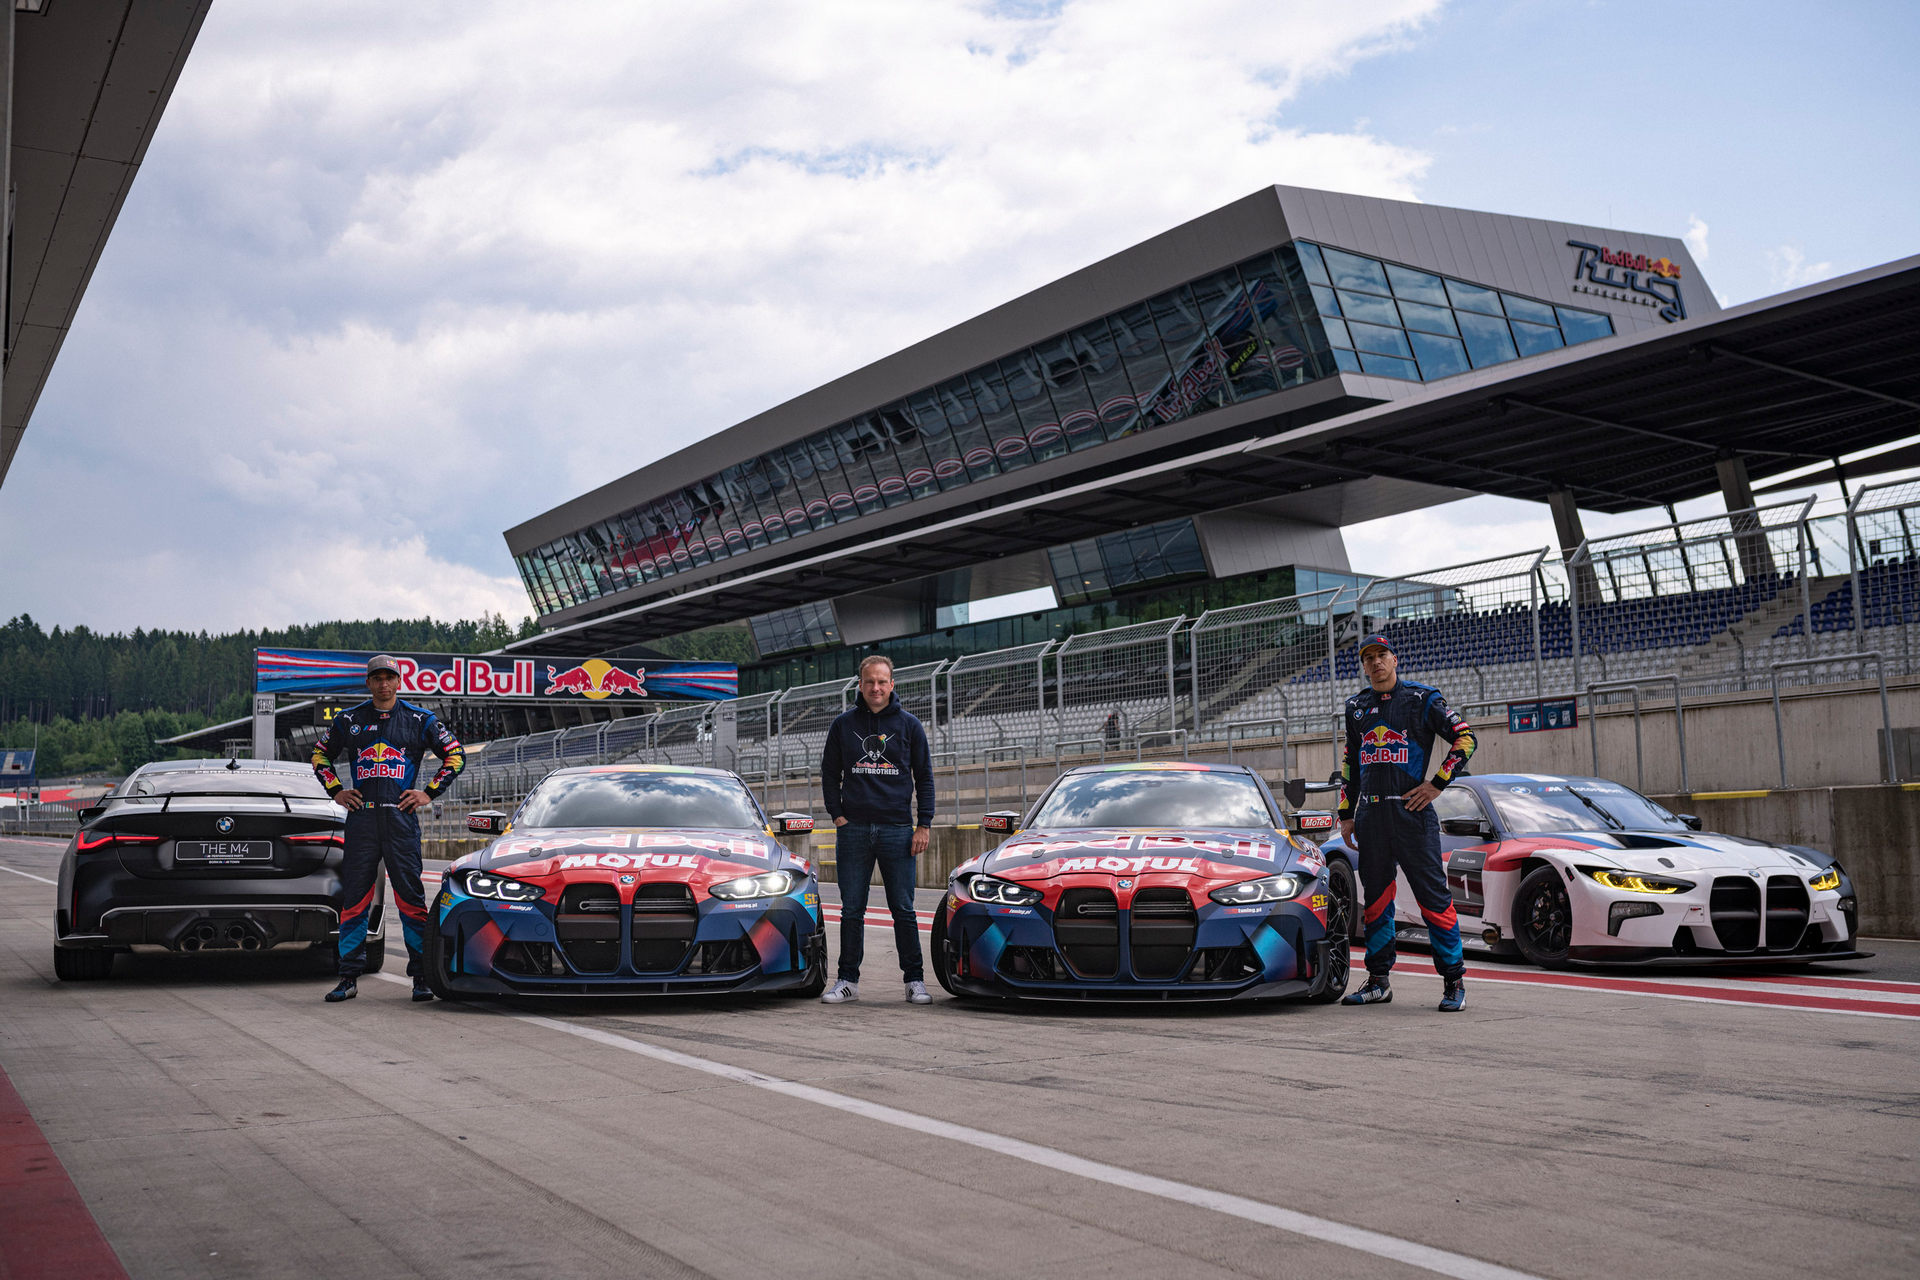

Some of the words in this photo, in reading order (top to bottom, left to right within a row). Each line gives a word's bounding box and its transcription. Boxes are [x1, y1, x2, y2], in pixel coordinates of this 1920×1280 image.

[1602, 246, 1625, 267] Red
[1625, 251, 1647, 272] Bull
[397, 657, 465, 695] Red
[467, 659, 535, 697] Bull
[1361, 748, 1380, 765] Red
[1381, 748, 1408, 764] Bull
[357, 763, 378, 780] Red
[379, 764, 405, 779] Bull
[851, 767, 899, 775] DRIFTBROTHERS
[789, 820, 813, 829] MoTeC
[983, 817, 1005, 827] MoTeC
[1305, 818, 1330, 827] MoTeC
[200, 844, 227, 854] THE
[230, 844, 249, 854] M4
[560, 853, 699, 870] MOTUL
[1058, 856, 1201, 873] MOTUL
[1460, 874, 1470, 899] 1
